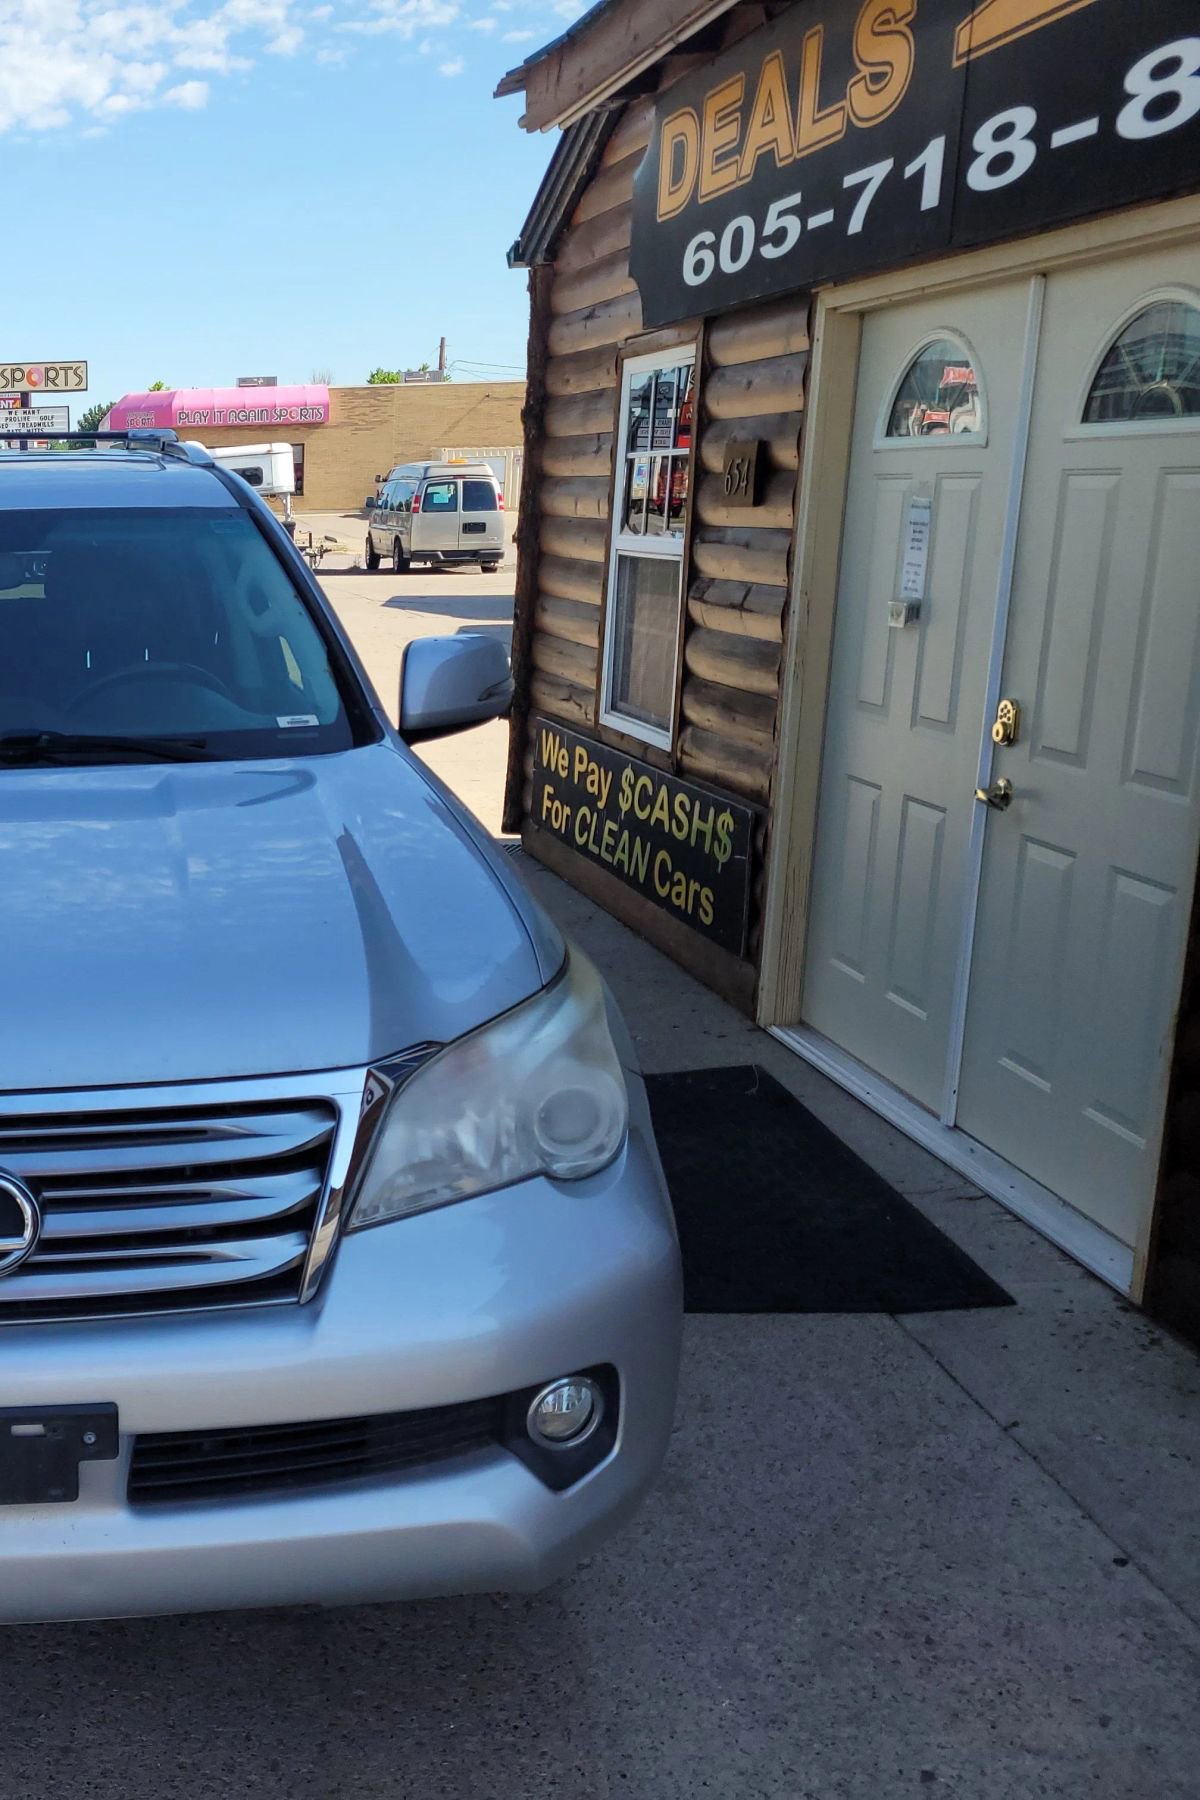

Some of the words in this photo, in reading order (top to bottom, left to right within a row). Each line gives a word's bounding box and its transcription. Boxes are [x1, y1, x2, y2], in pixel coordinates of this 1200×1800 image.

[656, 0, 917, 223] DEALS
[0, 366, 84, 389] SPORTS
[178, 411, 209, 425] PLAY
[213, 409, 225, 423] IT
[228, 408, 269, 423] AGAIN
[272, 406, 324, 421] SPORTS
[724, 458, 750, 496] 654
[541, 728, 570, 778] We
[574, 745, 613, 810] Pay
[619, 762, 735, 874] $CASH$
[542, 784, 571, 834] For
[574, 806, 651, 884] CLEAN
[654, 850, 714, 926] Cars
